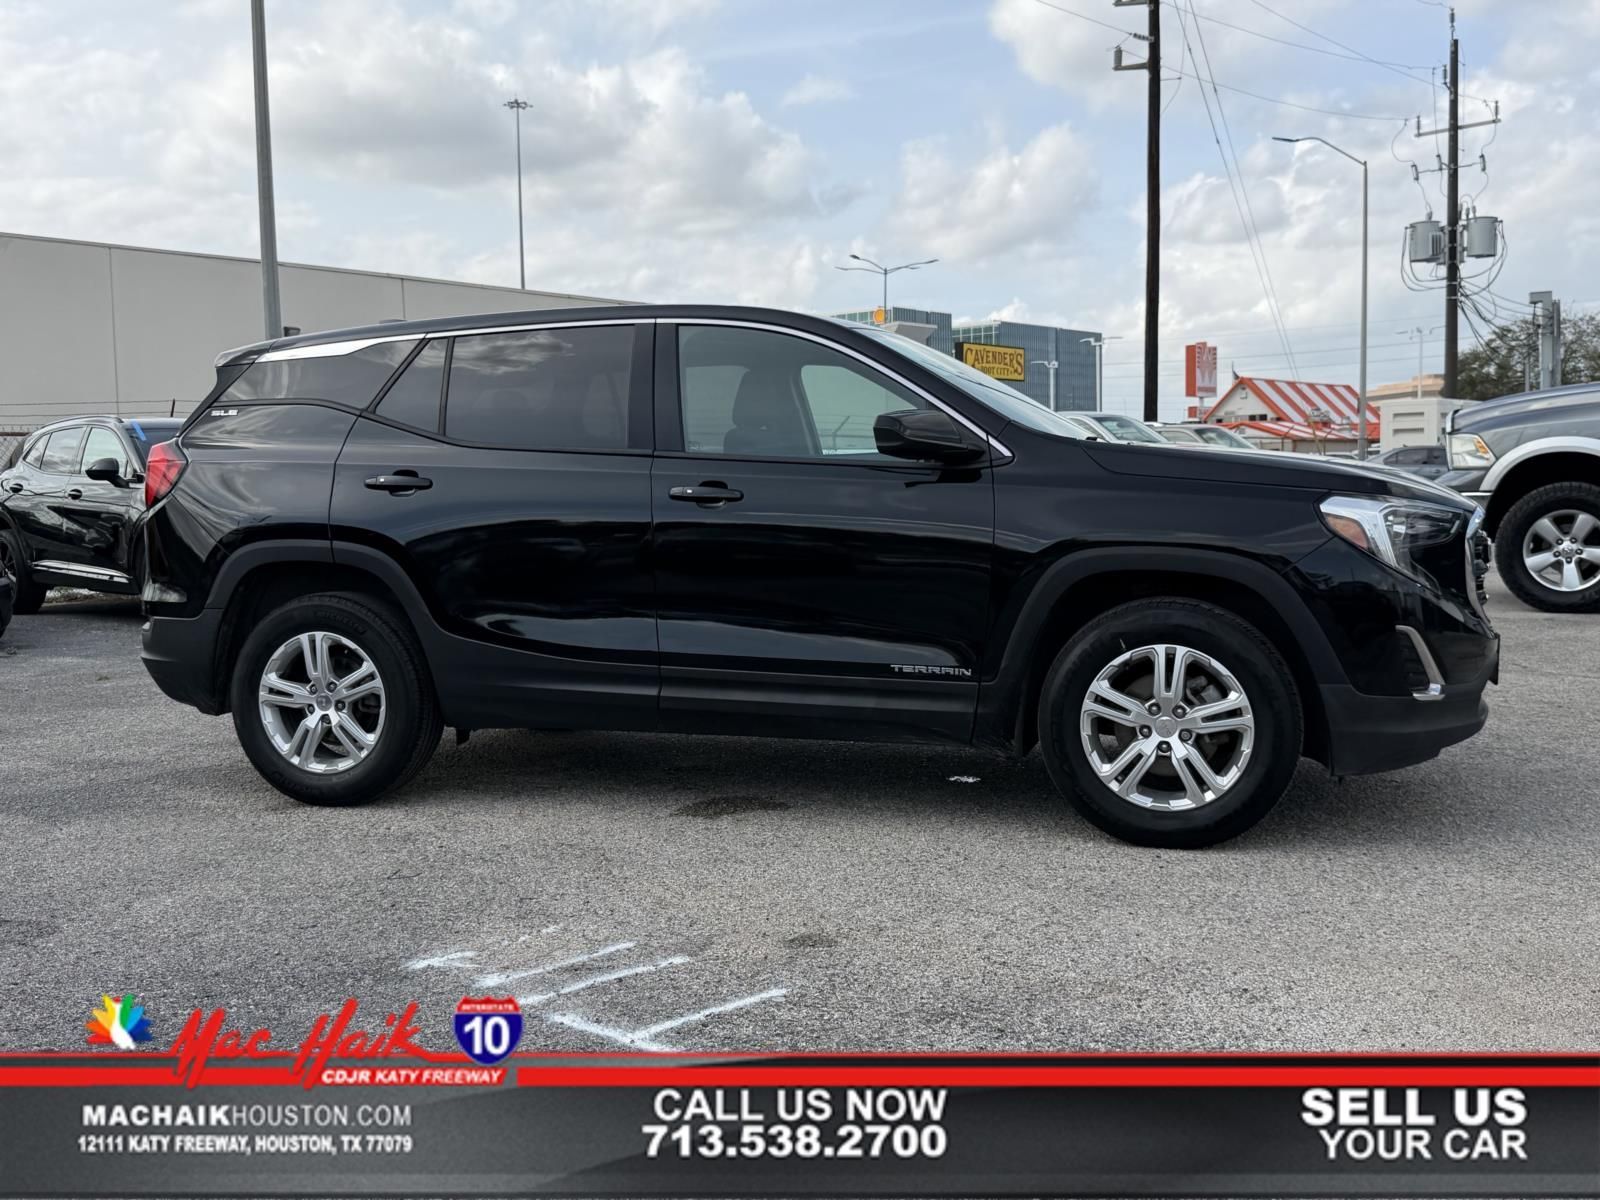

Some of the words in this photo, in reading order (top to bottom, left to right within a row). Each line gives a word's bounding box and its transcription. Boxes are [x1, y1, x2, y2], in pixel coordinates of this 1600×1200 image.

[965, 347, 1023, 376] CAVENDER'S
[996, 367, 1010, 377] CITY
[890, 664, 972, 676] TERRAIN
